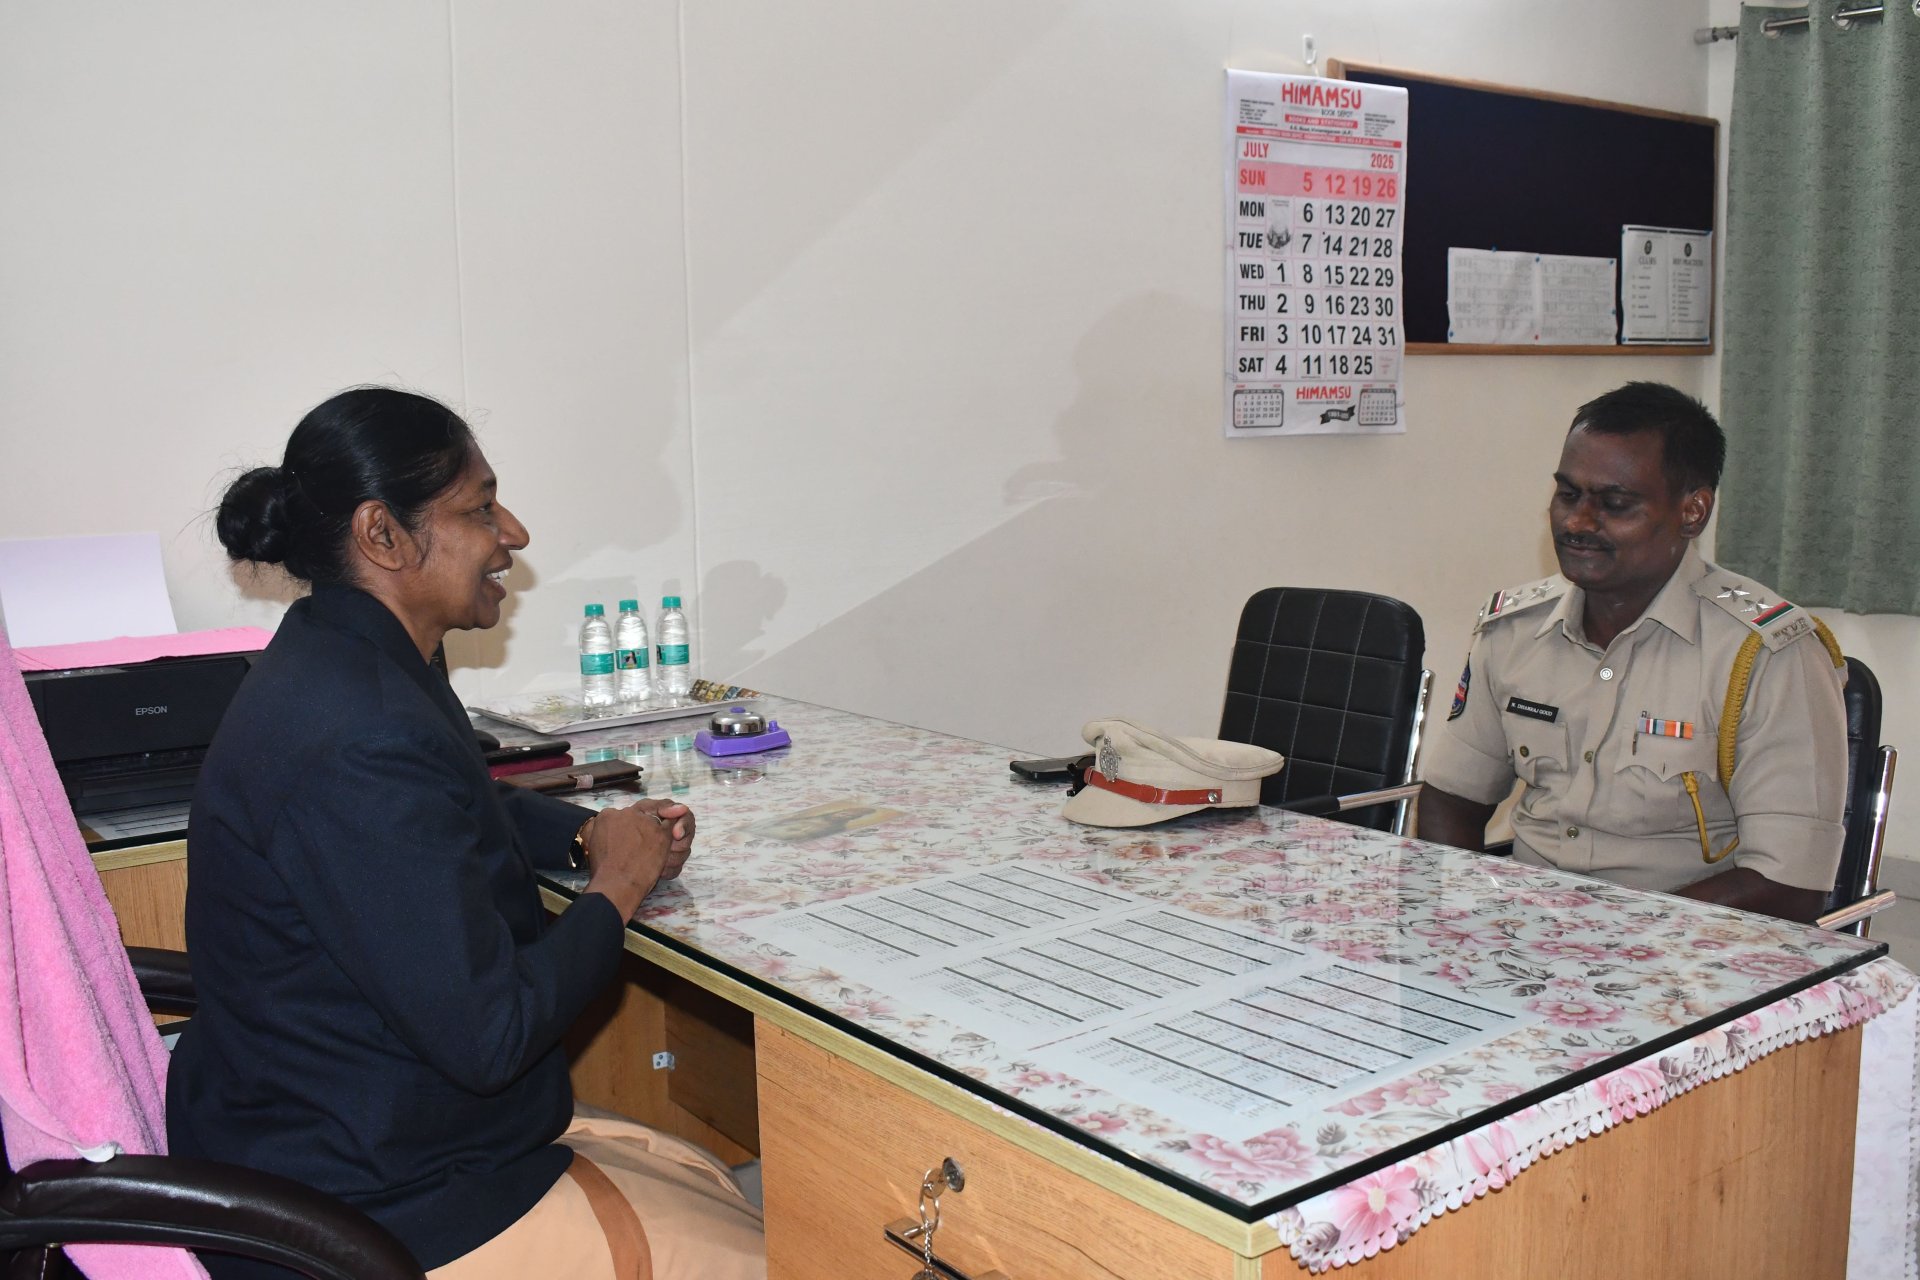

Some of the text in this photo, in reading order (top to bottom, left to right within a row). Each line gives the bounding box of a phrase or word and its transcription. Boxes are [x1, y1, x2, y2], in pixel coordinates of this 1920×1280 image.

[1282, 82, 1362, 109] HIMAMSU
[1244, 142, 1269, 158] JULY
[1371, 153, 1394, 169] 2026
[1241, 169, 1396, 198] SUN 5 12 19 26
[1240, 201, 1395, 228] MON 6 13 20 27
[1239, 232, 1393, 258] TUE 7 14 21 28
[1240, 263, 1394, 287] WED 1 8 15 22 29
[1240, 293, 1393, 317] THU 2 9 16 23 30
[1241, 324, 1396, 346] FRI 3 10 17 24 31
[1239, 357, 1264, 373] SAT
[1275, 355, 1287, 375] 4
[1303, 355, 1321, 375] 11
[1329, 355, 1349, 375] 18
[1354, 356, 1373, 375] 25
[1296, 386, 1352, 400] HIMAMSU
[136, 706, 168, 716] EPSON
